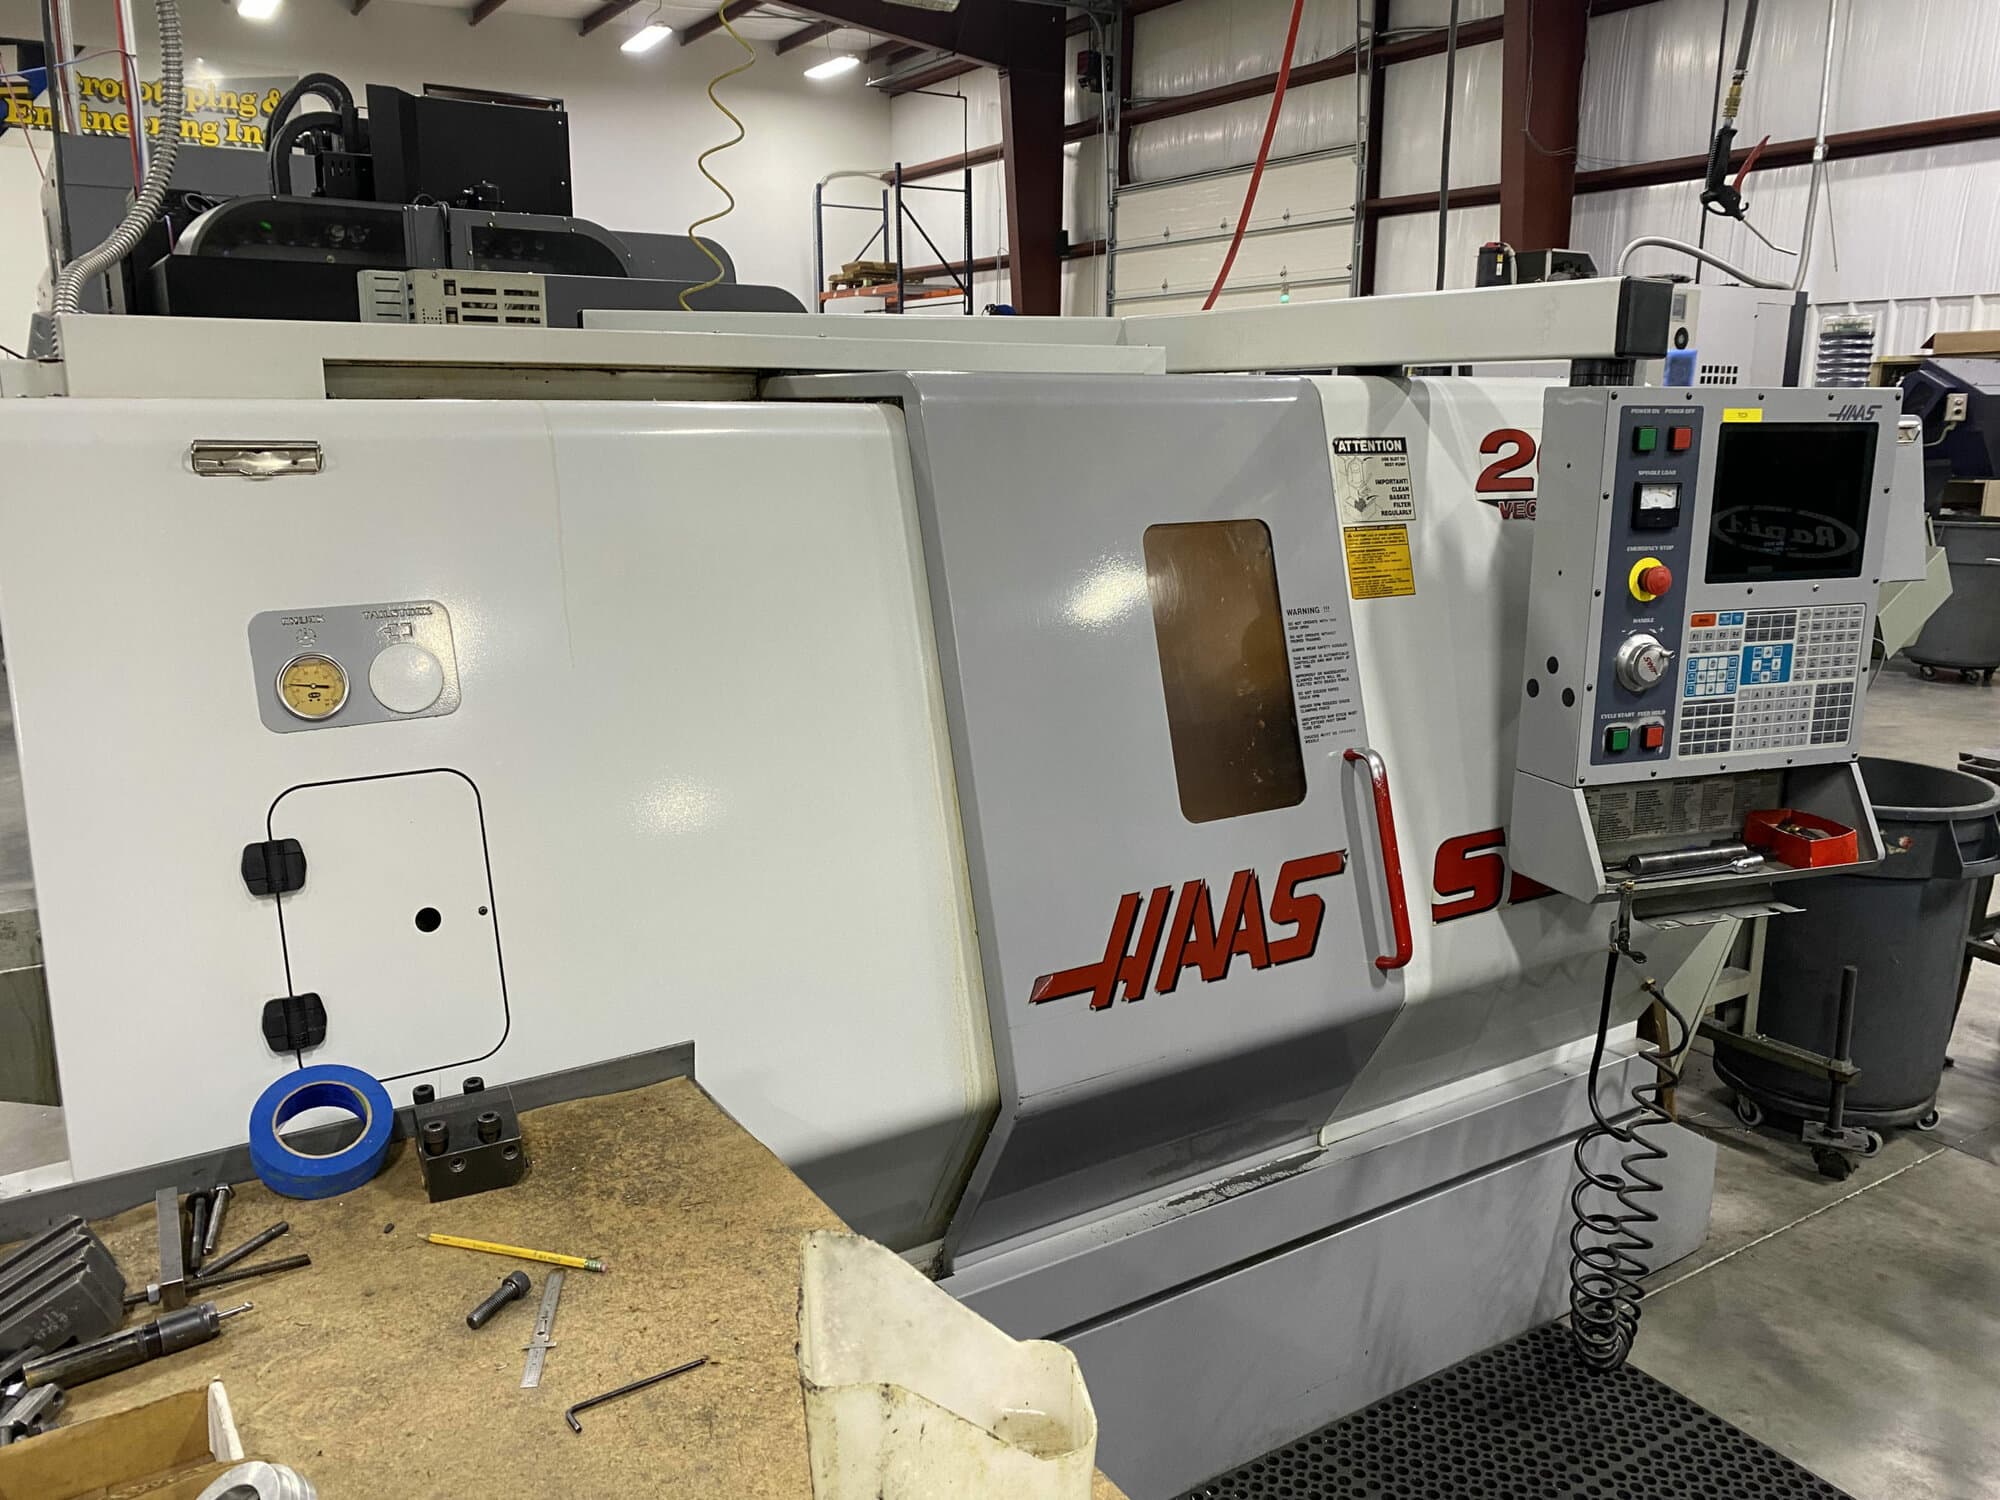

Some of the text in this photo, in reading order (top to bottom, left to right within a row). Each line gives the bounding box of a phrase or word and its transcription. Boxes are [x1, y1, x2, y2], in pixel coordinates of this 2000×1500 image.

[1828, 405, 1882, 421] HAAS
[1338, 440, 1402, 452] ATTENTION
[1476, 428, 1541, 493] 2
[362, 606, 432, 620] TAILSTOCK
[1286, 606, 1320, 616] WARNING
[281, 614, 326, 626] CHUCK
[1029, 849, 1348, 1011] HAAS
